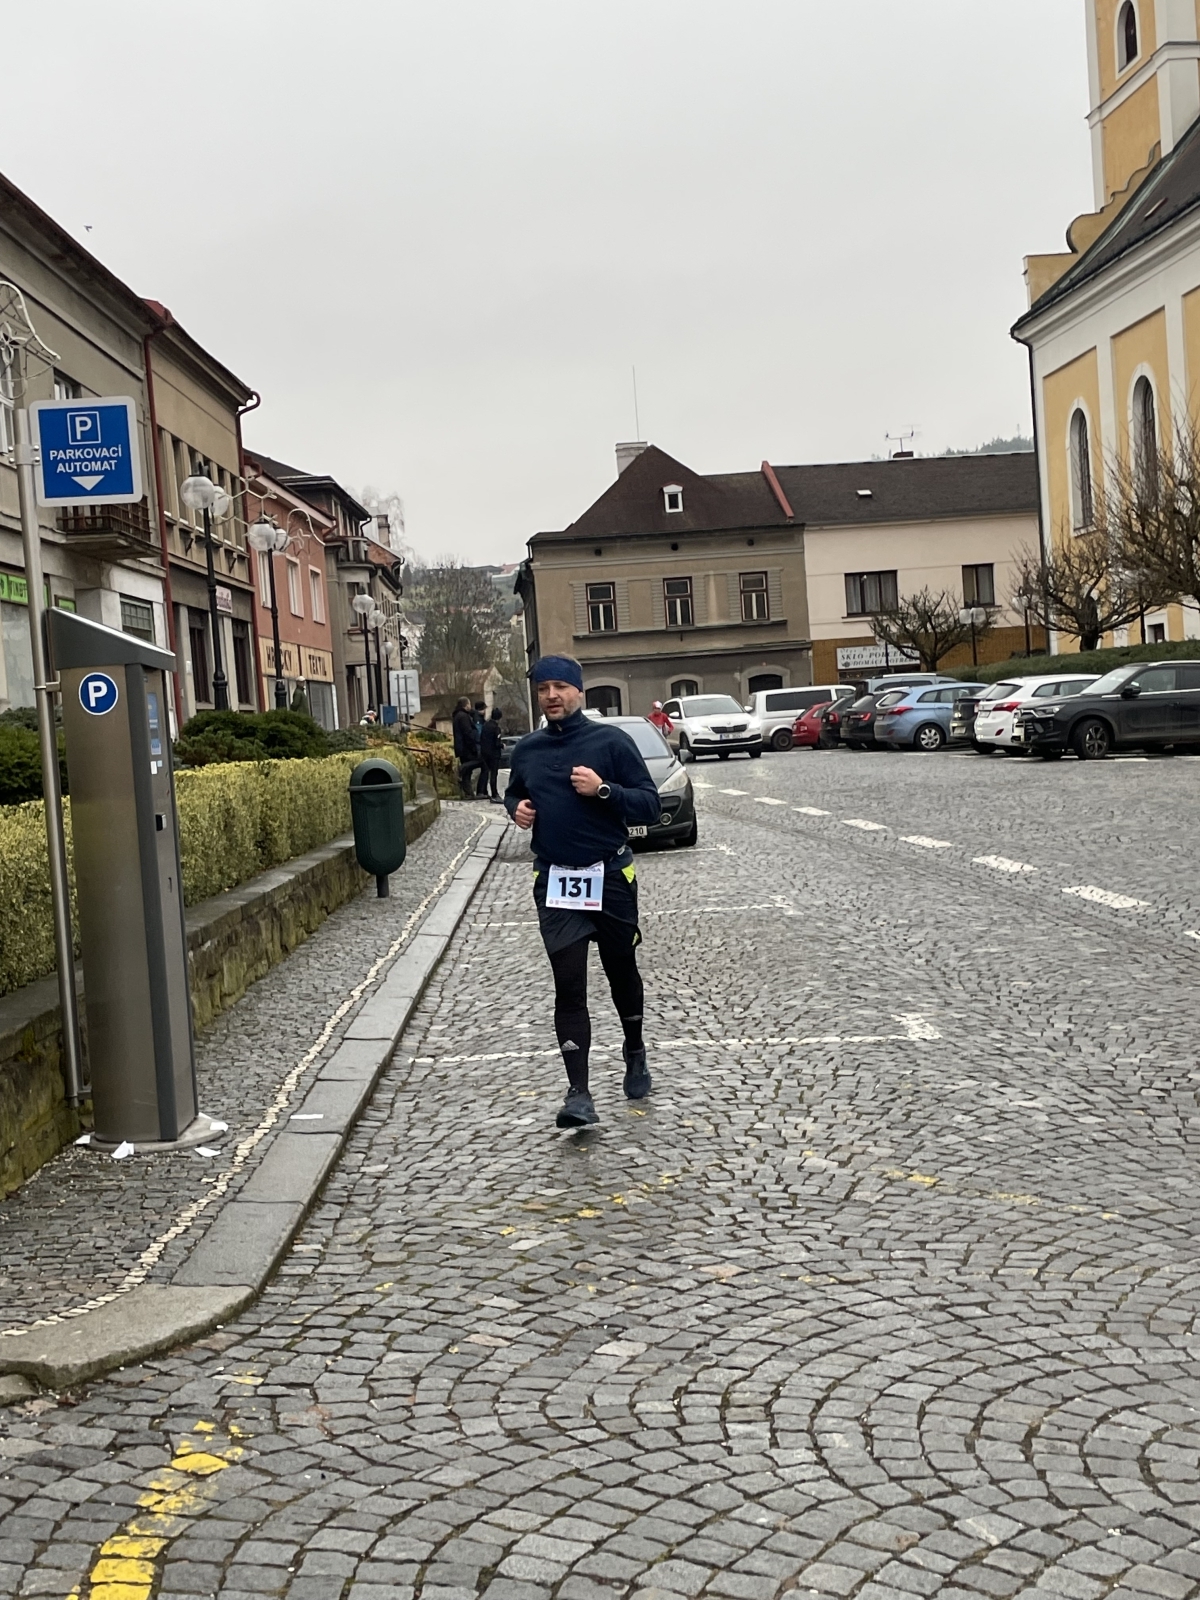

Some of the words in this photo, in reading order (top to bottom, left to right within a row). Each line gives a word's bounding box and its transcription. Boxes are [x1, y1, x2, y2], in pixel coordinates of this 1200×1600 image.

[75, 416, 92, 440] P
[50, 444, 122, 461] PARKOVACÍ
[56, 460, 118, 473] AUTOMAT
[266, 643, 292, 671] HRČKY
[308, 654, 327, 676] TEXTIL
[841, 652, 864, 660] SKLO
[88, 681, 108, 707] P
[629, 827, 644, 836] 210
[558, 877, 592, 898] 131
